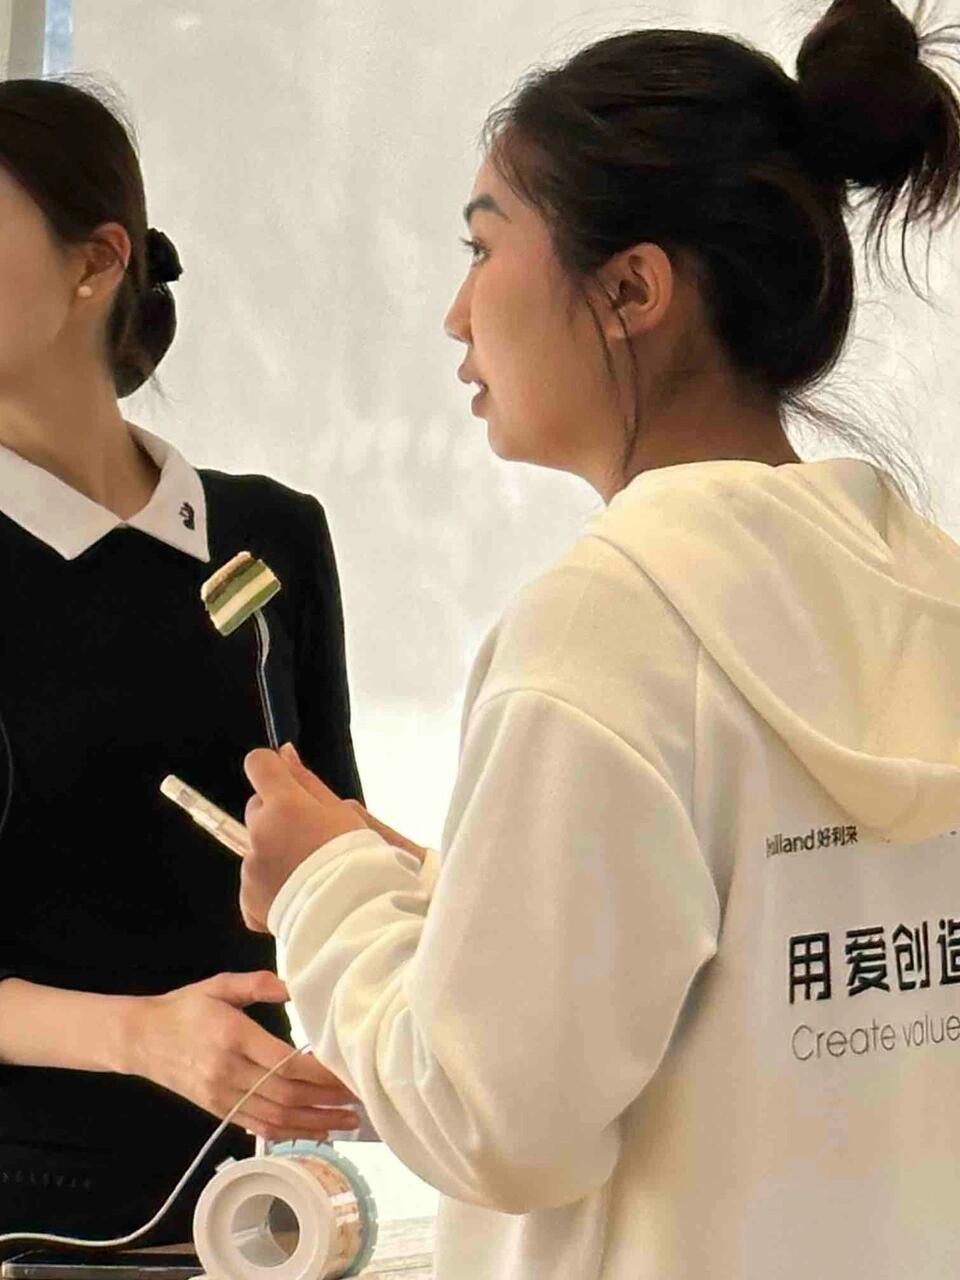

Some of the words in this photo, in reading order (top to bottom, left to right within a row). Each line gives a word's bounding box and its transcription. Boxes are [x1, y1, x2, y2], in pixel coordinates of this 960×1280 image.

[817, 825, 859, 849] 好利来
[789, 918, 960, 1005] 用爱创造
[791, 1017, 896, 1061] Create
[903, 1010, 960, 1048] value
